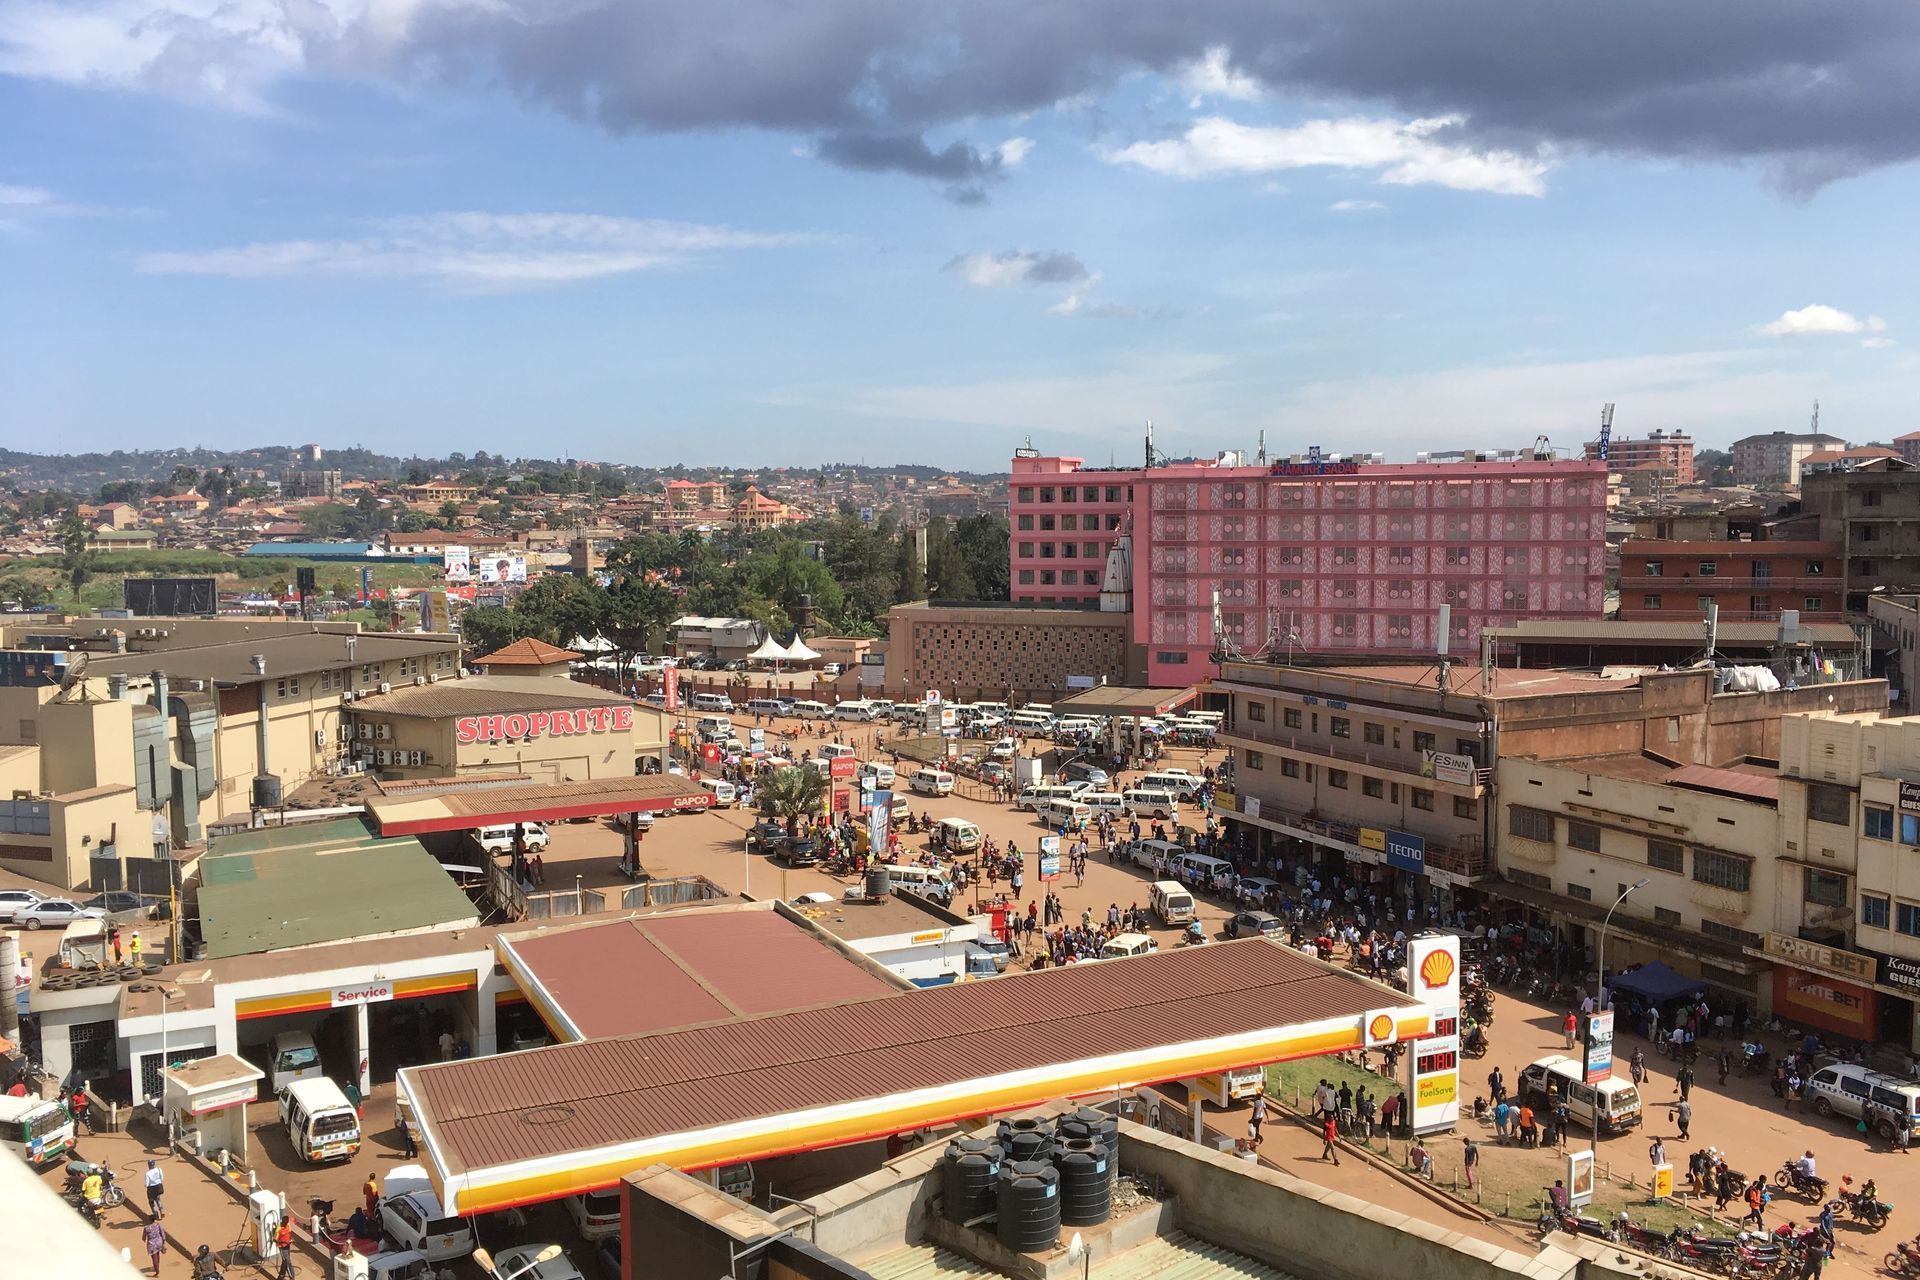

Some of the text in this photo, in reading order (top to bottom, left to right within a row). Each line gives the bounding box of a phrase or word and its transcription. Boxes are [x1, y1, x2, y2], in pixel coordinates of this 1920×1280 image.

[1601, 433, 1609, 460] BAPS
[1324, 463, 1359, 474] SADAN
[457, 705, 634, 743] SHOPRITE
[1426, 750, 1469, 769] YES INN
[673, 795, 709, 806] GAPCO
[1388, 842, 1422, 861] TECNO
[338, 986, 387, 1001] Service
[1420, 1081, 1433, 1090] Shell
[1420, 1086, 1454, 1098] FuelSave
